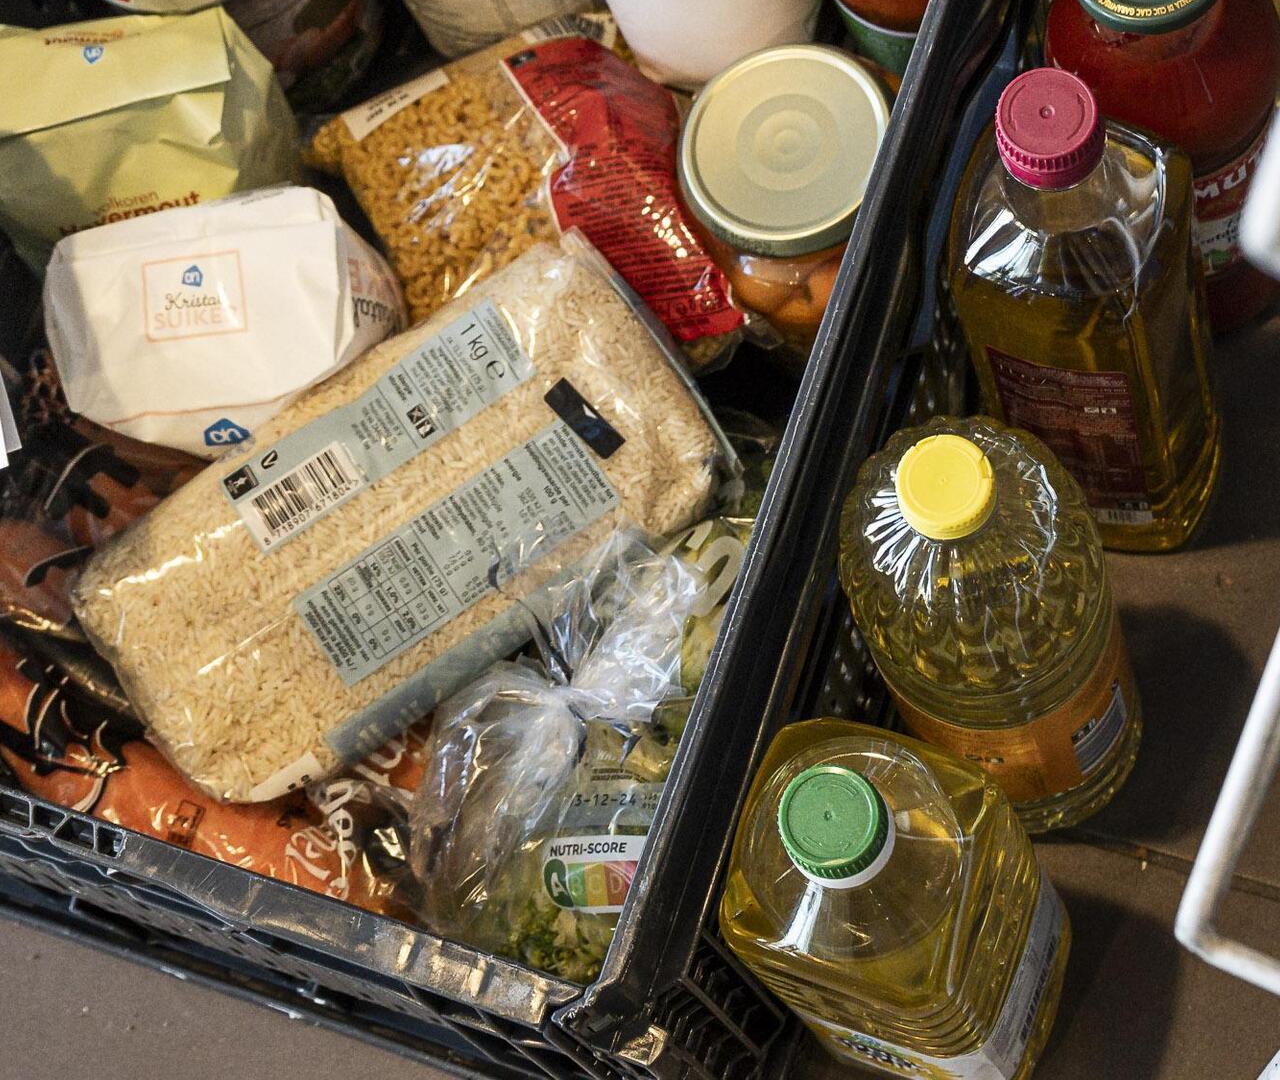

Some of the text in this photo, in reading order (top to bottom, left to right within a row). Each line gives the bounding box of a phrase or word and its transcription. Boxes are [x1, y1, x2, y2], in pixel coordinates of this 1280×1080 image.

[164, 291, 222, 311] Krista
[154, 307, 230, 330] SUIKE
[460, 323, 489, 361] 1 kg
[275, 509, 313, 538] 718907
[315, 486, 352, 511] 671804
[571, 792, 638, 808] 3-12-24
[549, 841, 628, 858] NUTRI-SCORE
